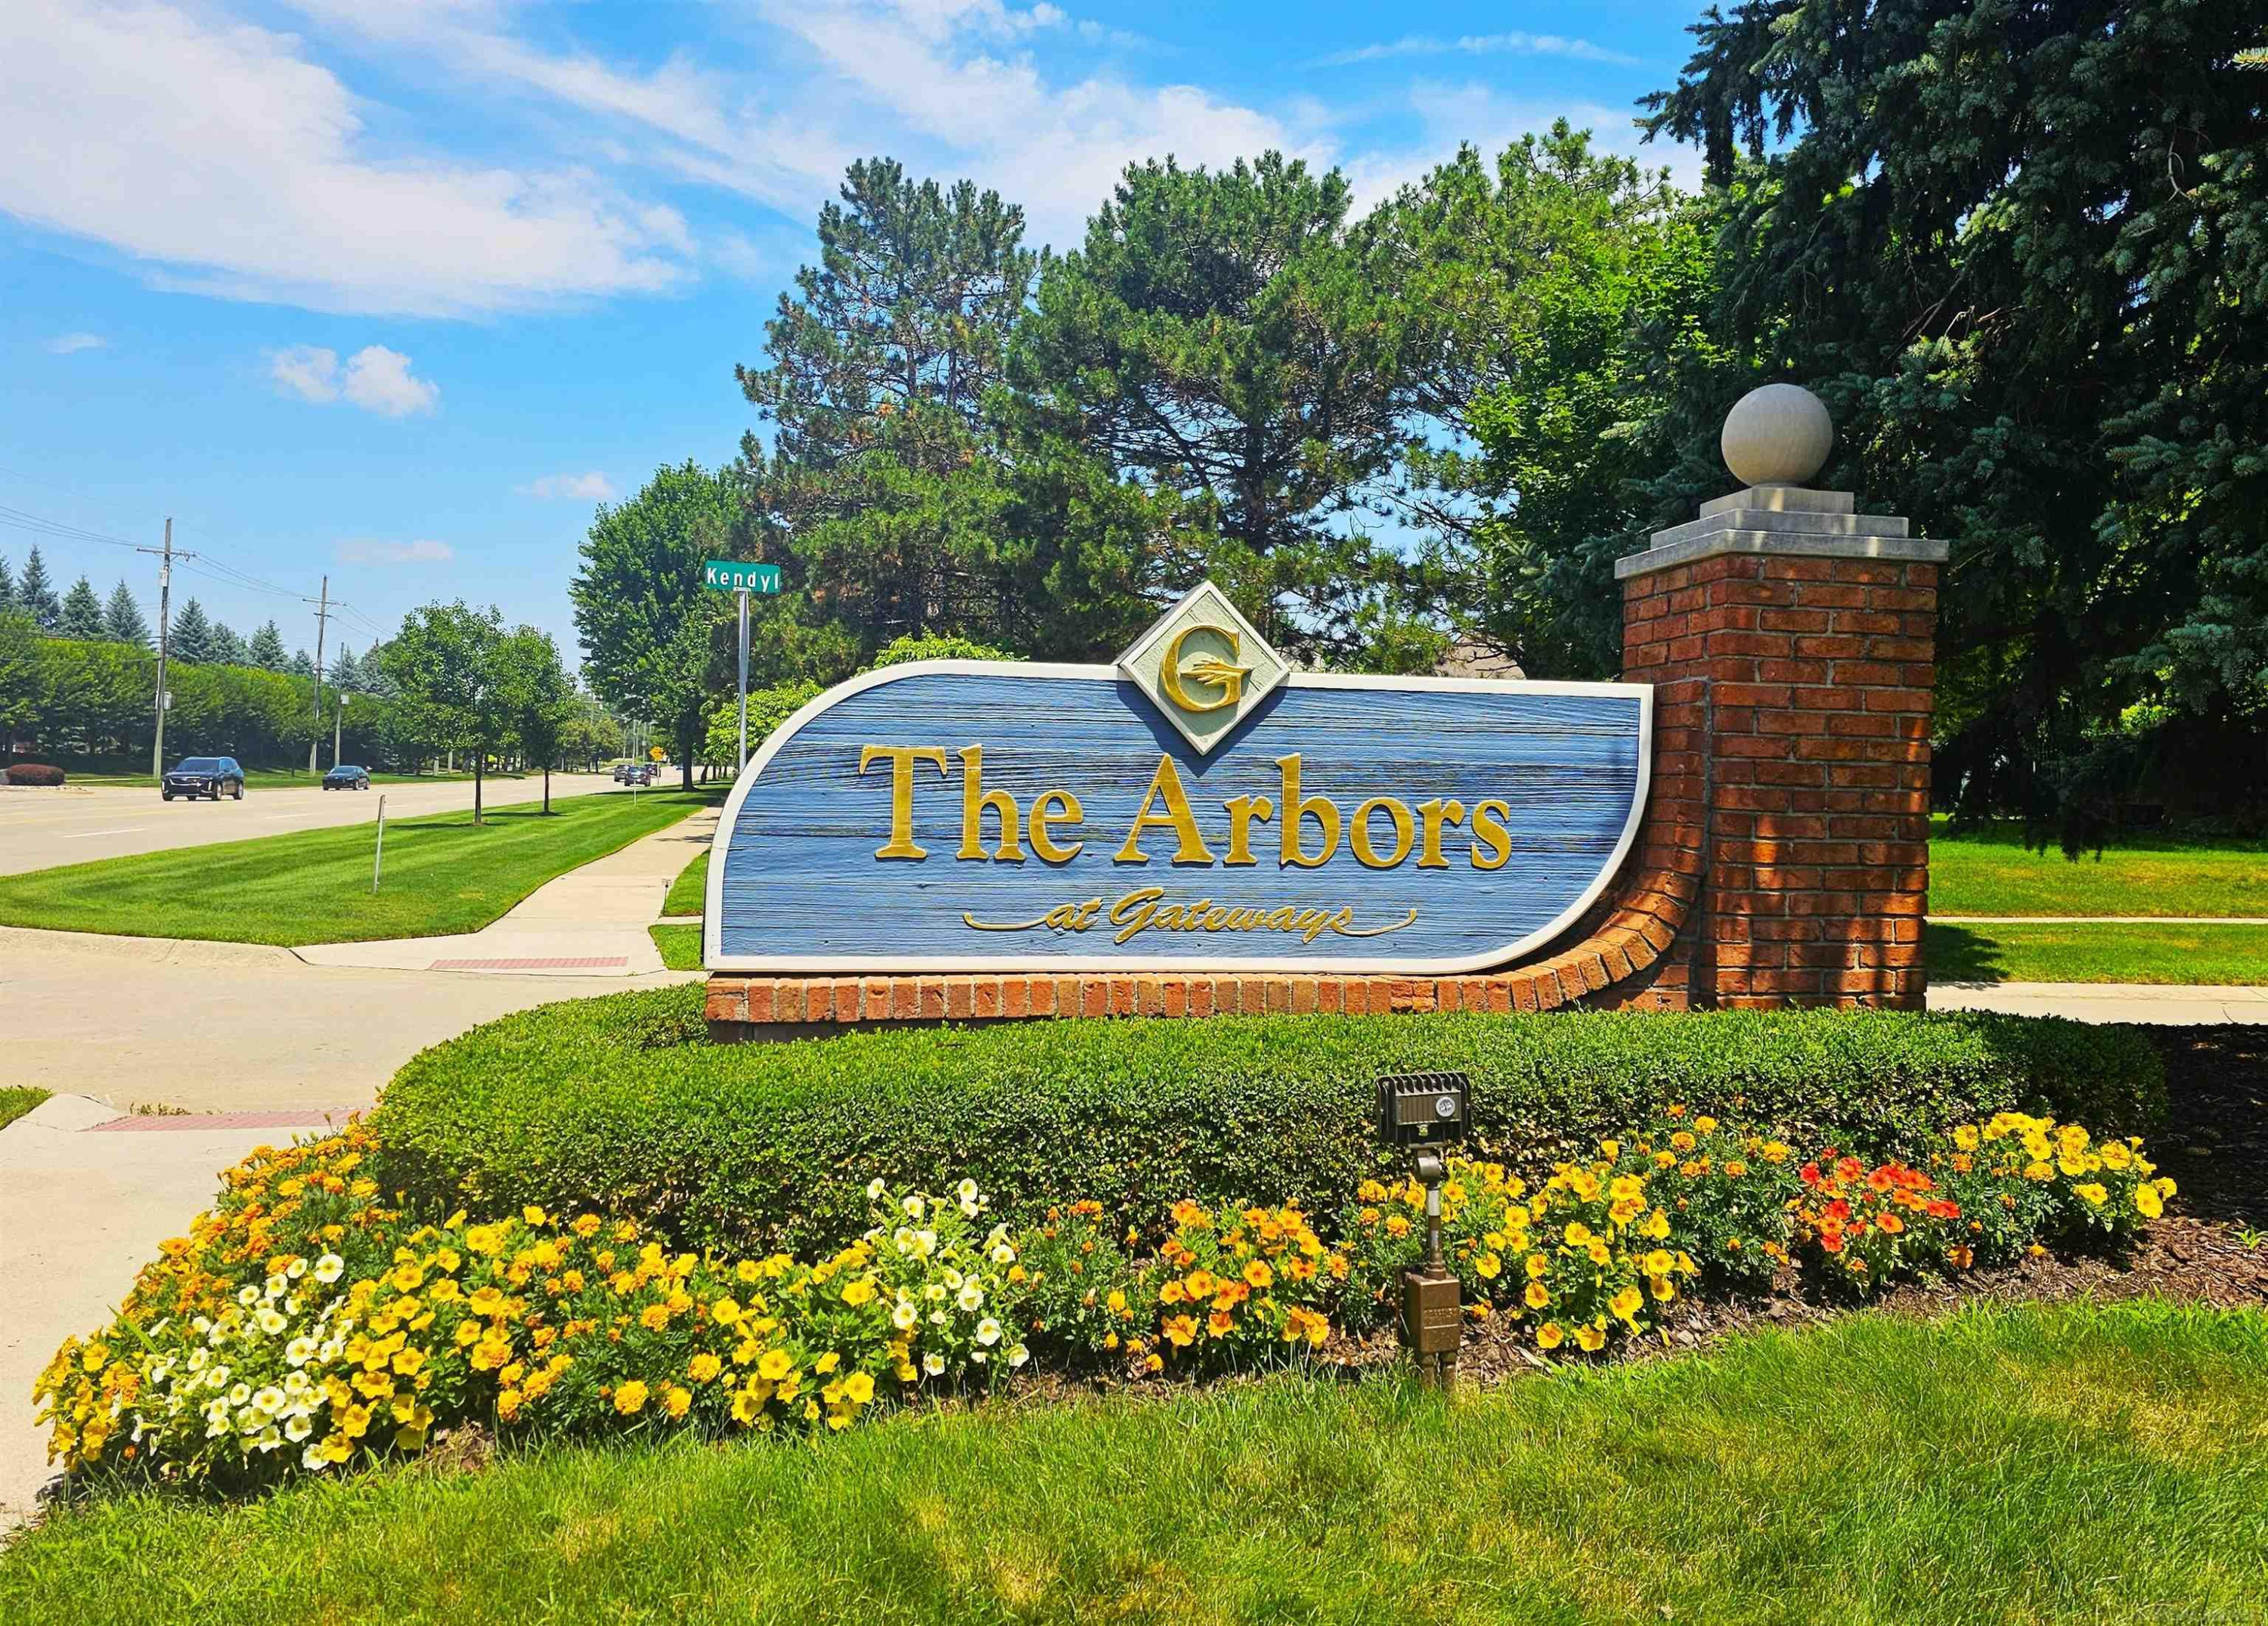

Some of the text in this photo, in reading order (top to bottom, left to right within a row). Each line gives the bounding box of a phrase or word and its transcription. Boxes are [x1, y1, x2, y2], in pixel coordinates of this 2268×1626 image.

[707, 567, 779, 592] Kendyl
[859, 743, 1513, 869] The Arbors
[1109, 887, 1355, 944] Gateways
